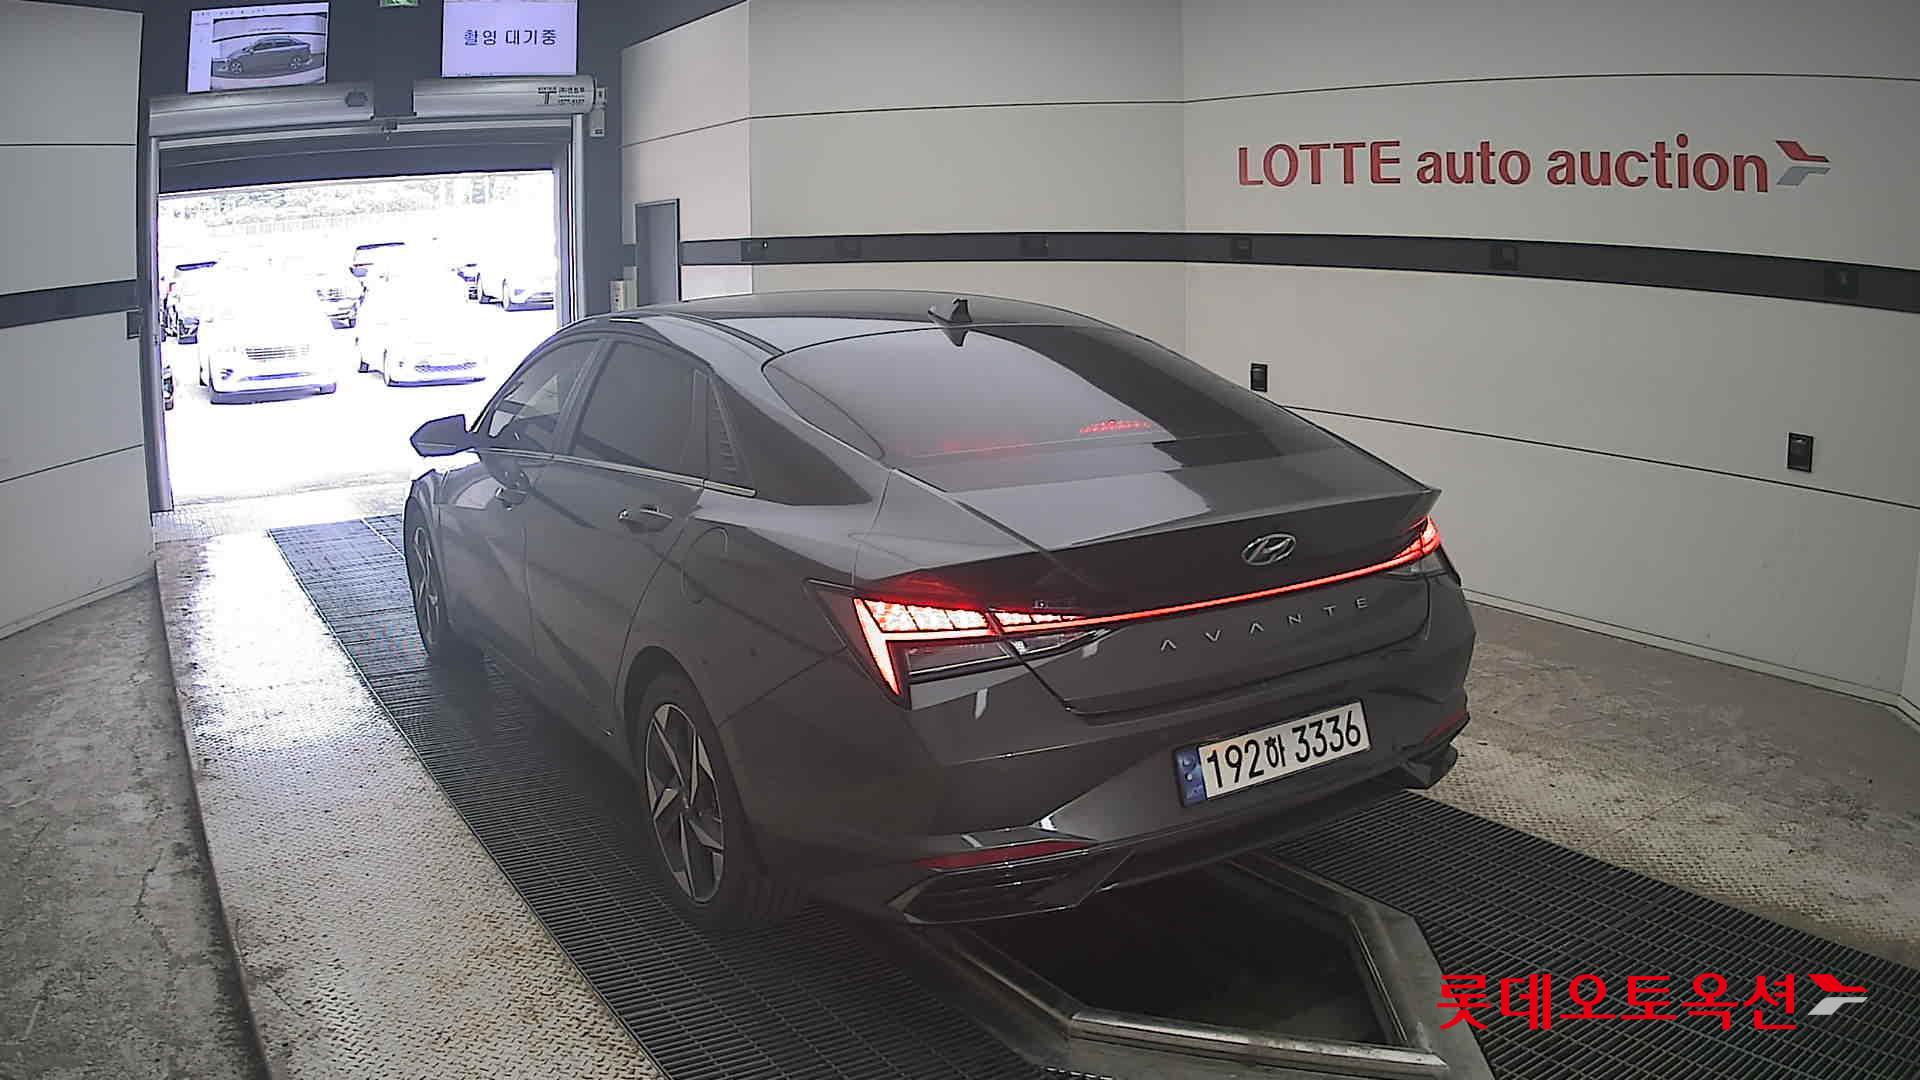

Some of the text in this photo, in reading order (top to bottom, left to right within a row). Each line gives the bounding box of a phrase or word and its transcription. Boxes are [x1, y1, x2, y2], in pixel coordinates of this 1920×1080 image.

[505, 29, 557, 46] 대기중
[1238, 133, 1768, 192] LOTTE auto auction
[1160, 597, 1368, 651] AVANTE
[1207, 710, 1361, 789] 192하 3336
